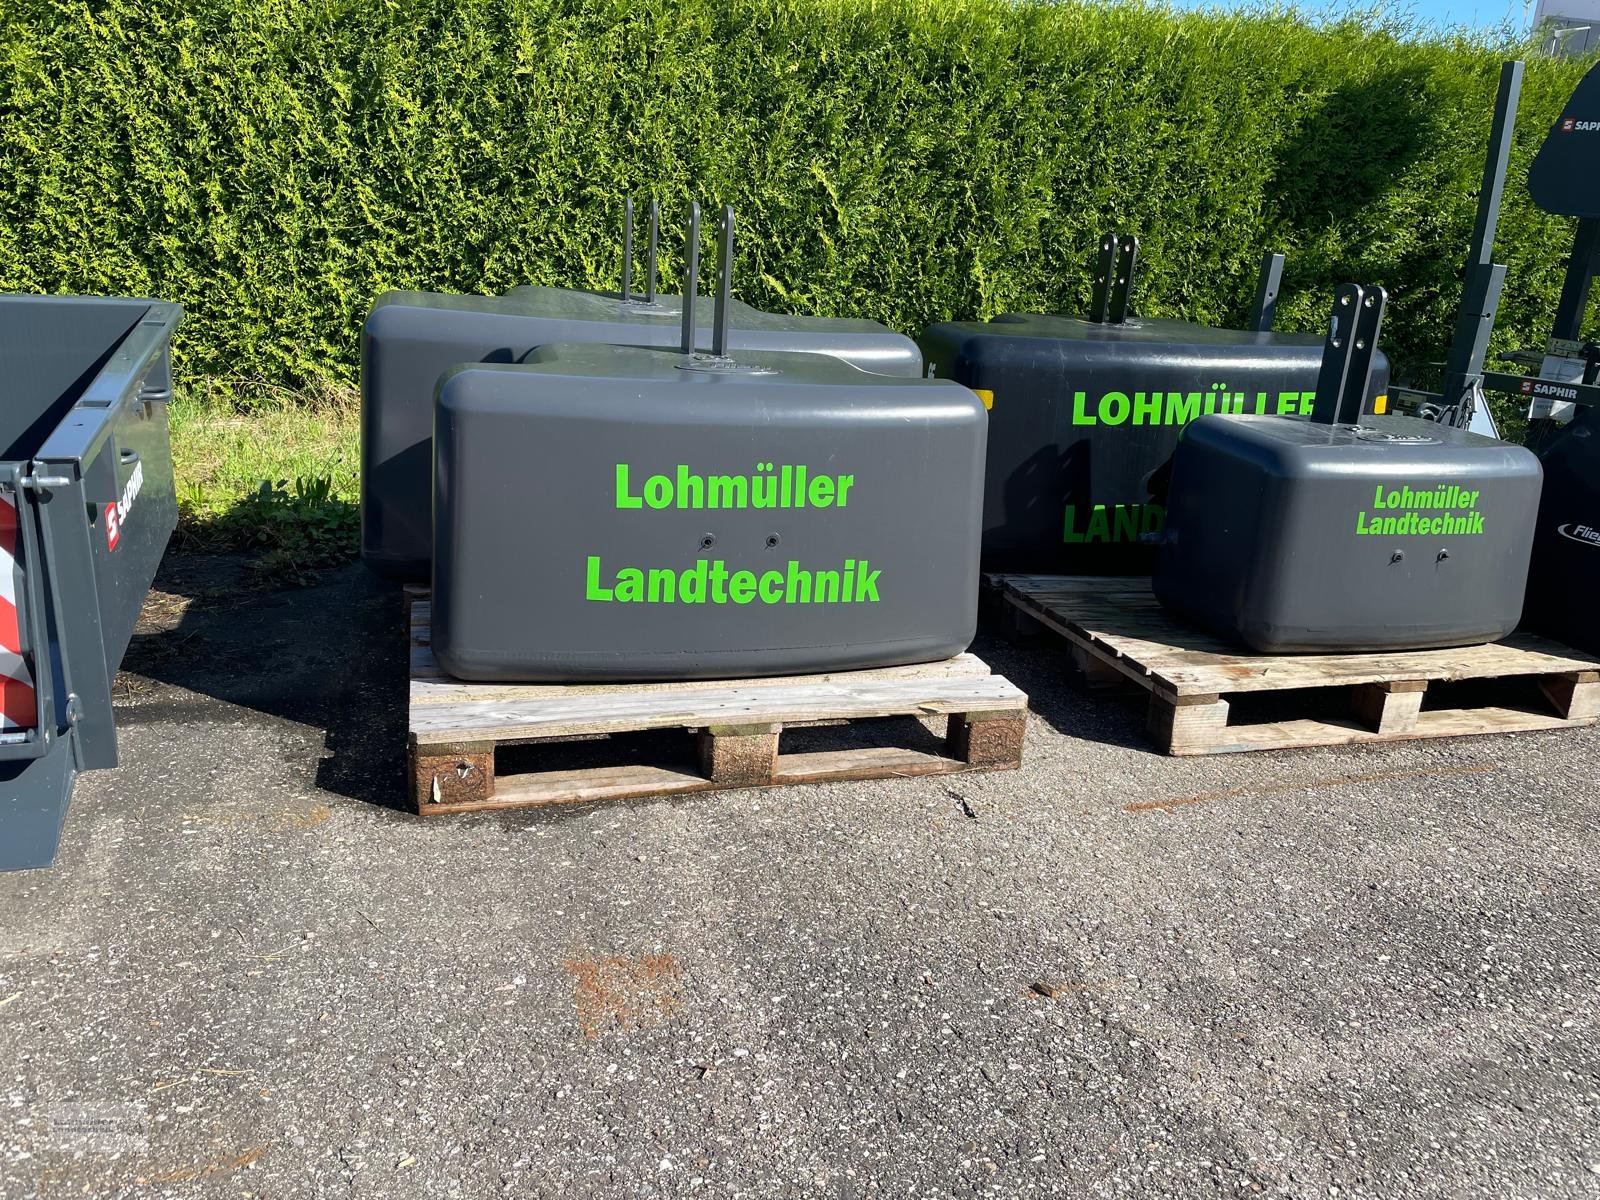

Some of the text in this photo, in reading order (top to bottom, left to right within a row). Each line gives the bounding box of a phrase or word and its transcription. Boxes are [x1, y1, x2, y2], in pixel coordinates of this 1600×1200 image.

[1533, 383, 1578, 399] SAPHIR
[117, 460, 144, 527] SAPHIR
[615, 462, 854, 509] Lohmüller
[1373, 484, 1480, 509] Lohmüller
[1356, 511, 1485, 535] Landtechnik
[585, 556, 882, 604] Landtechnik
